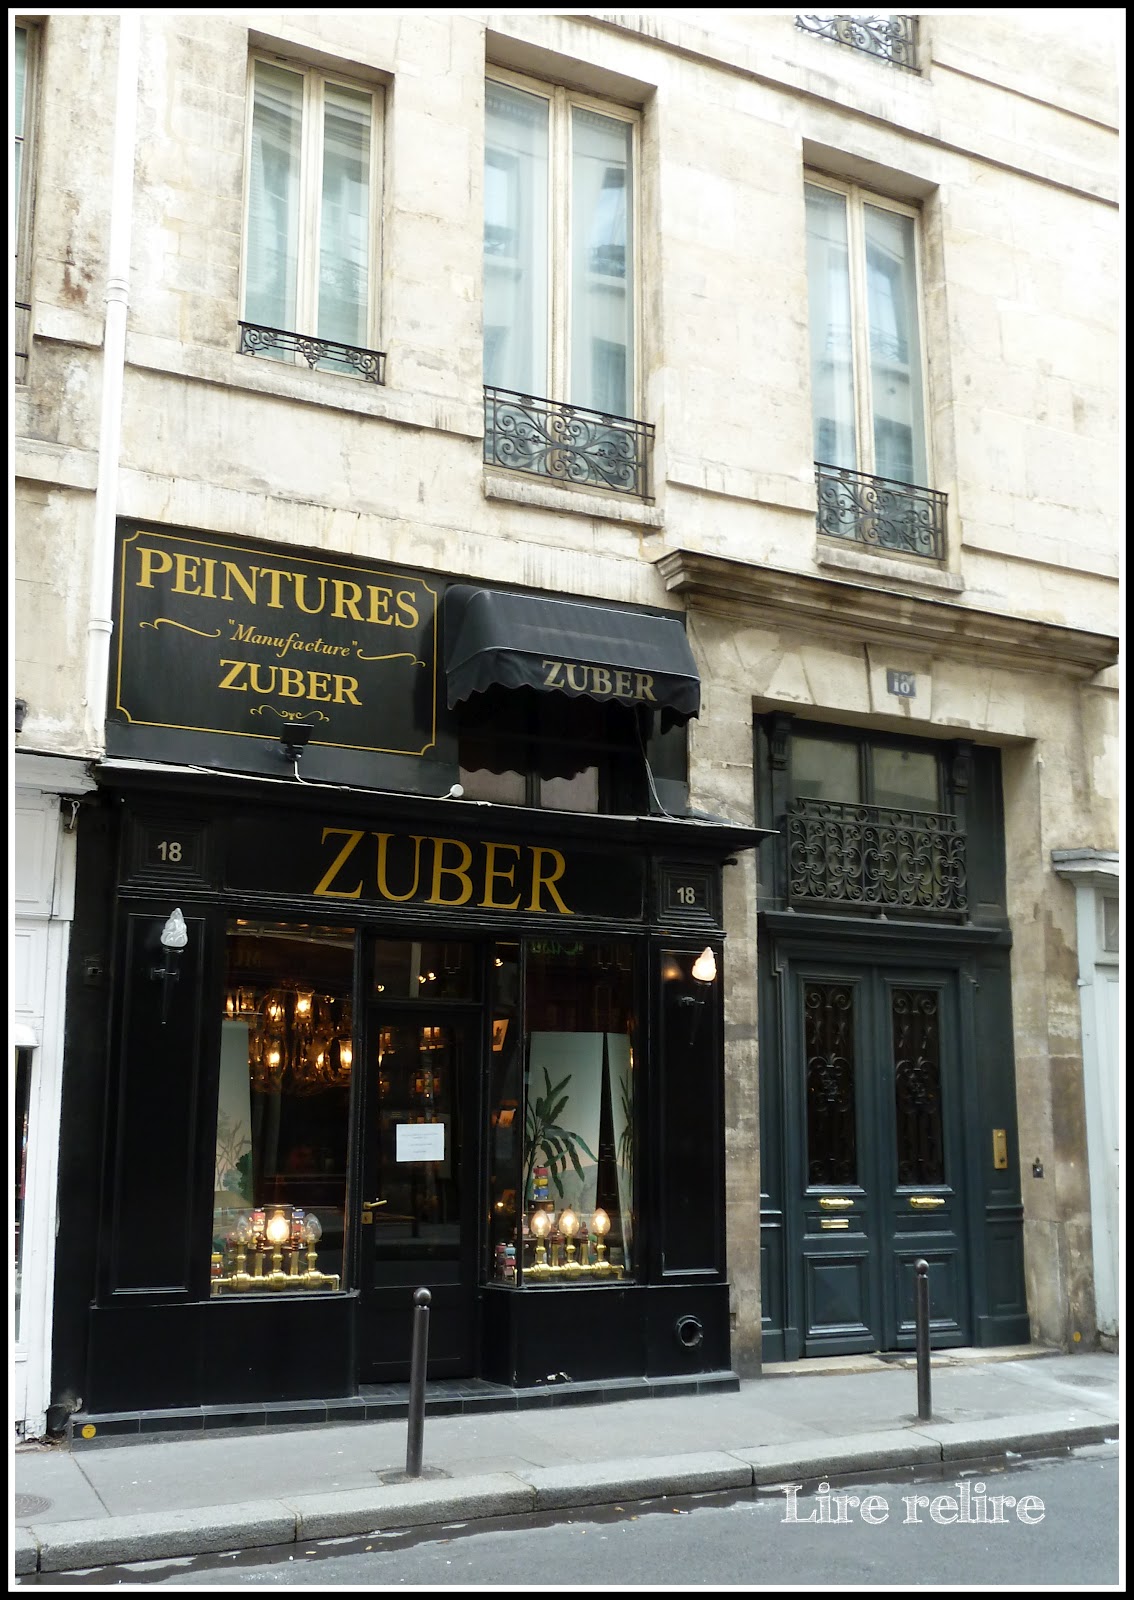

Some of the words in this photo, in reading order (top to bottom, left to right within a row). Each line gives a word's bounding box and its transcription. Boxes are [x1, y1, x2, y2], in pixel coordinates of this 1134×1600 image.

[135, 546, 420, 629] PEINTURES
[228, 618, 358, 658] "Manufacture"
[218, 658, 363, 706] ZUBER
[542, 660, 657, 701] ZUBER
[157, 841, 183, 862] 18
[313, 826, 575, 915] ZUBER
[677, 887, 696, 905] 18
